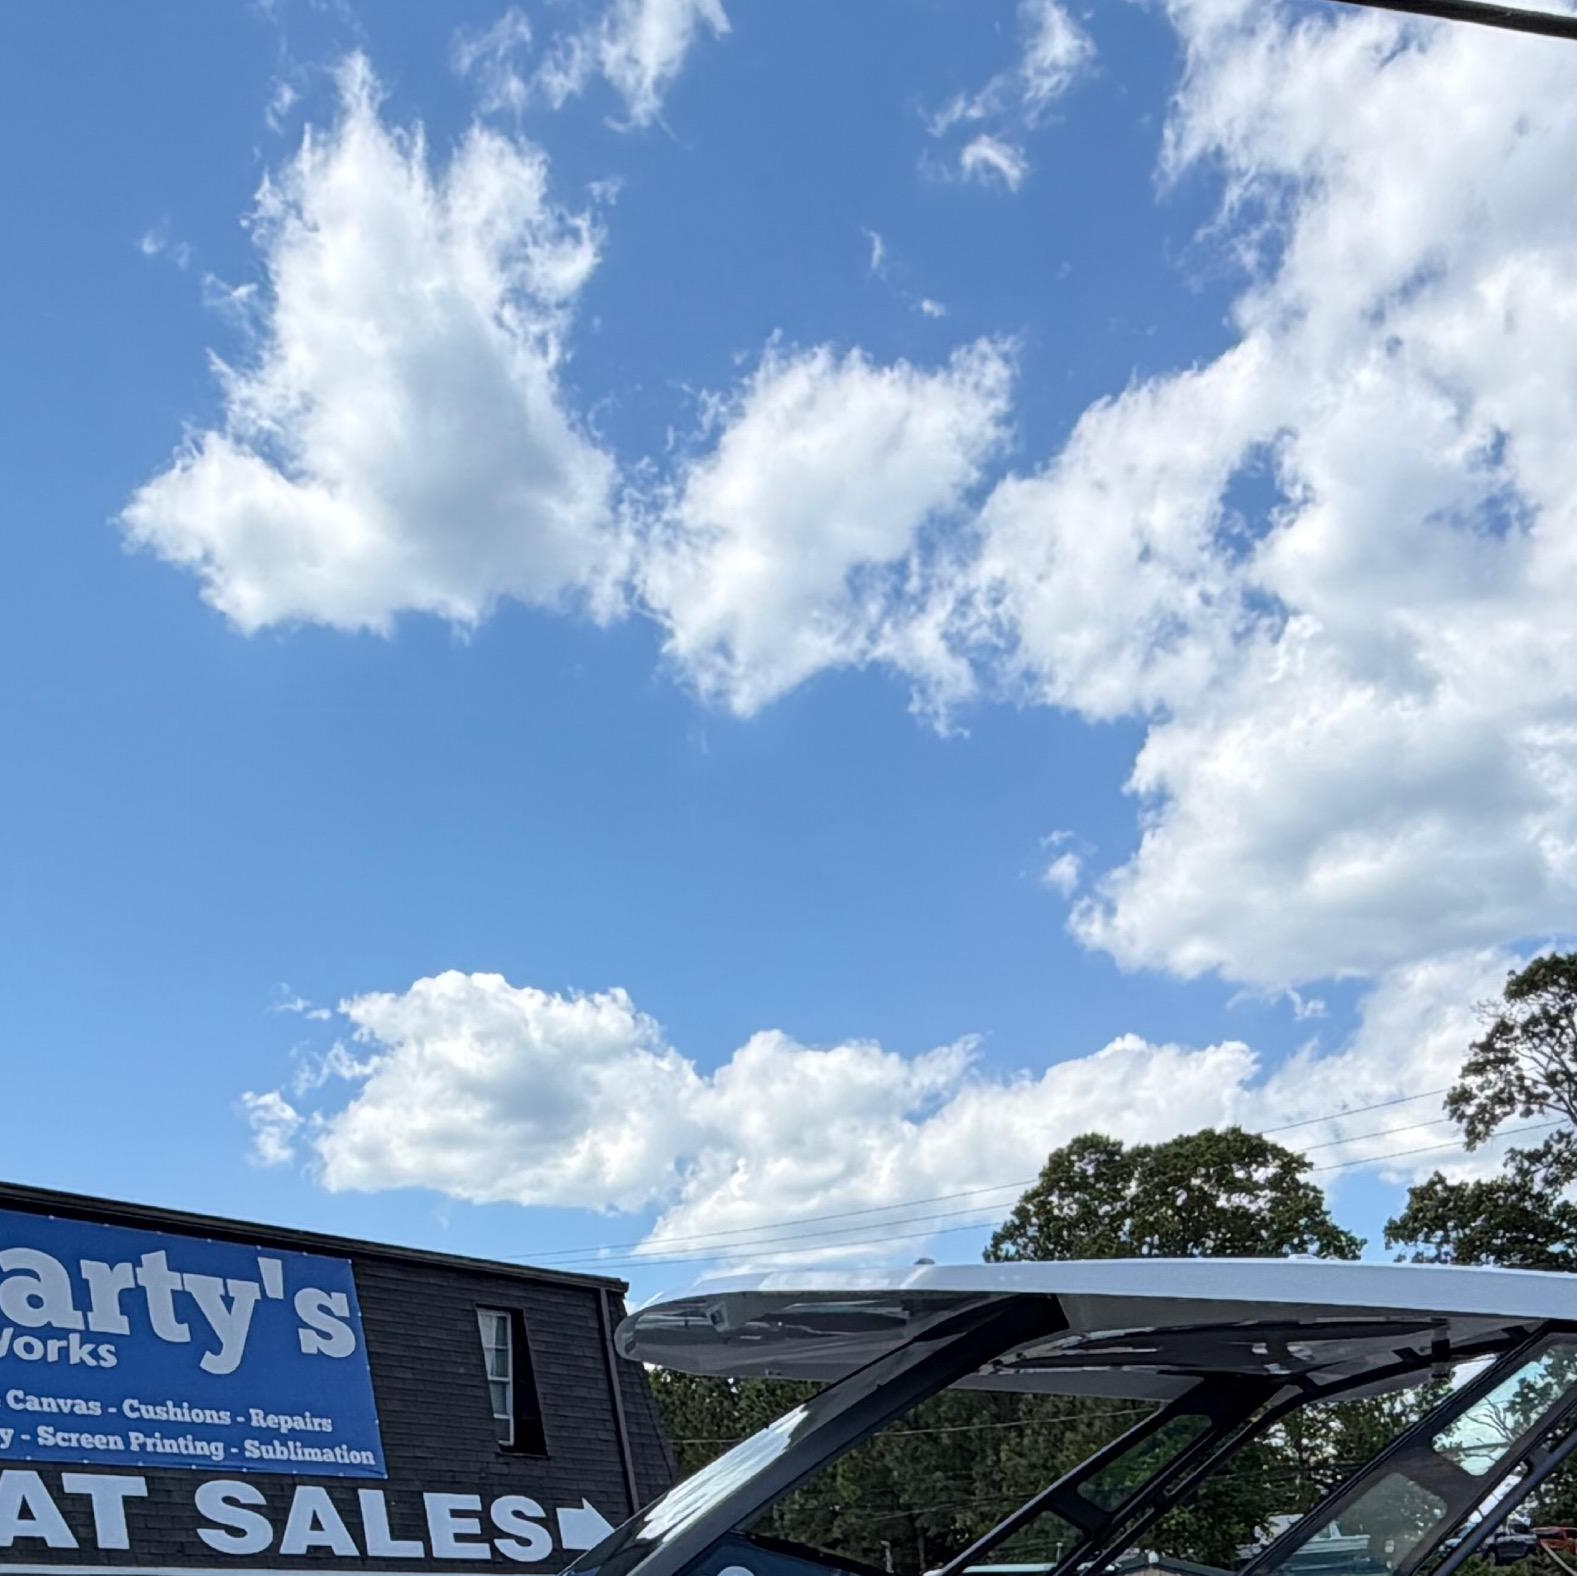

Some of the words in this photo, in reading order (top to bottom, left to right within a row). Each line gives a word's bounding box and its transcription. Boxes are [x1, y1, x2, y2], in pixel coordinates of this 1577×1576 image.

[6, 1389, 102, 1417] Canvas
[122, 1398, 232, 1426] Cushions
[249, 1408, 333, 1433] Repairs
[37, 1426, 125, 1452] Screen
[128, 1431, 225, 1462] Printing
[244, 1439, 376, 1466] Sublimation
[193, 1480, 554, 1563] SALES
